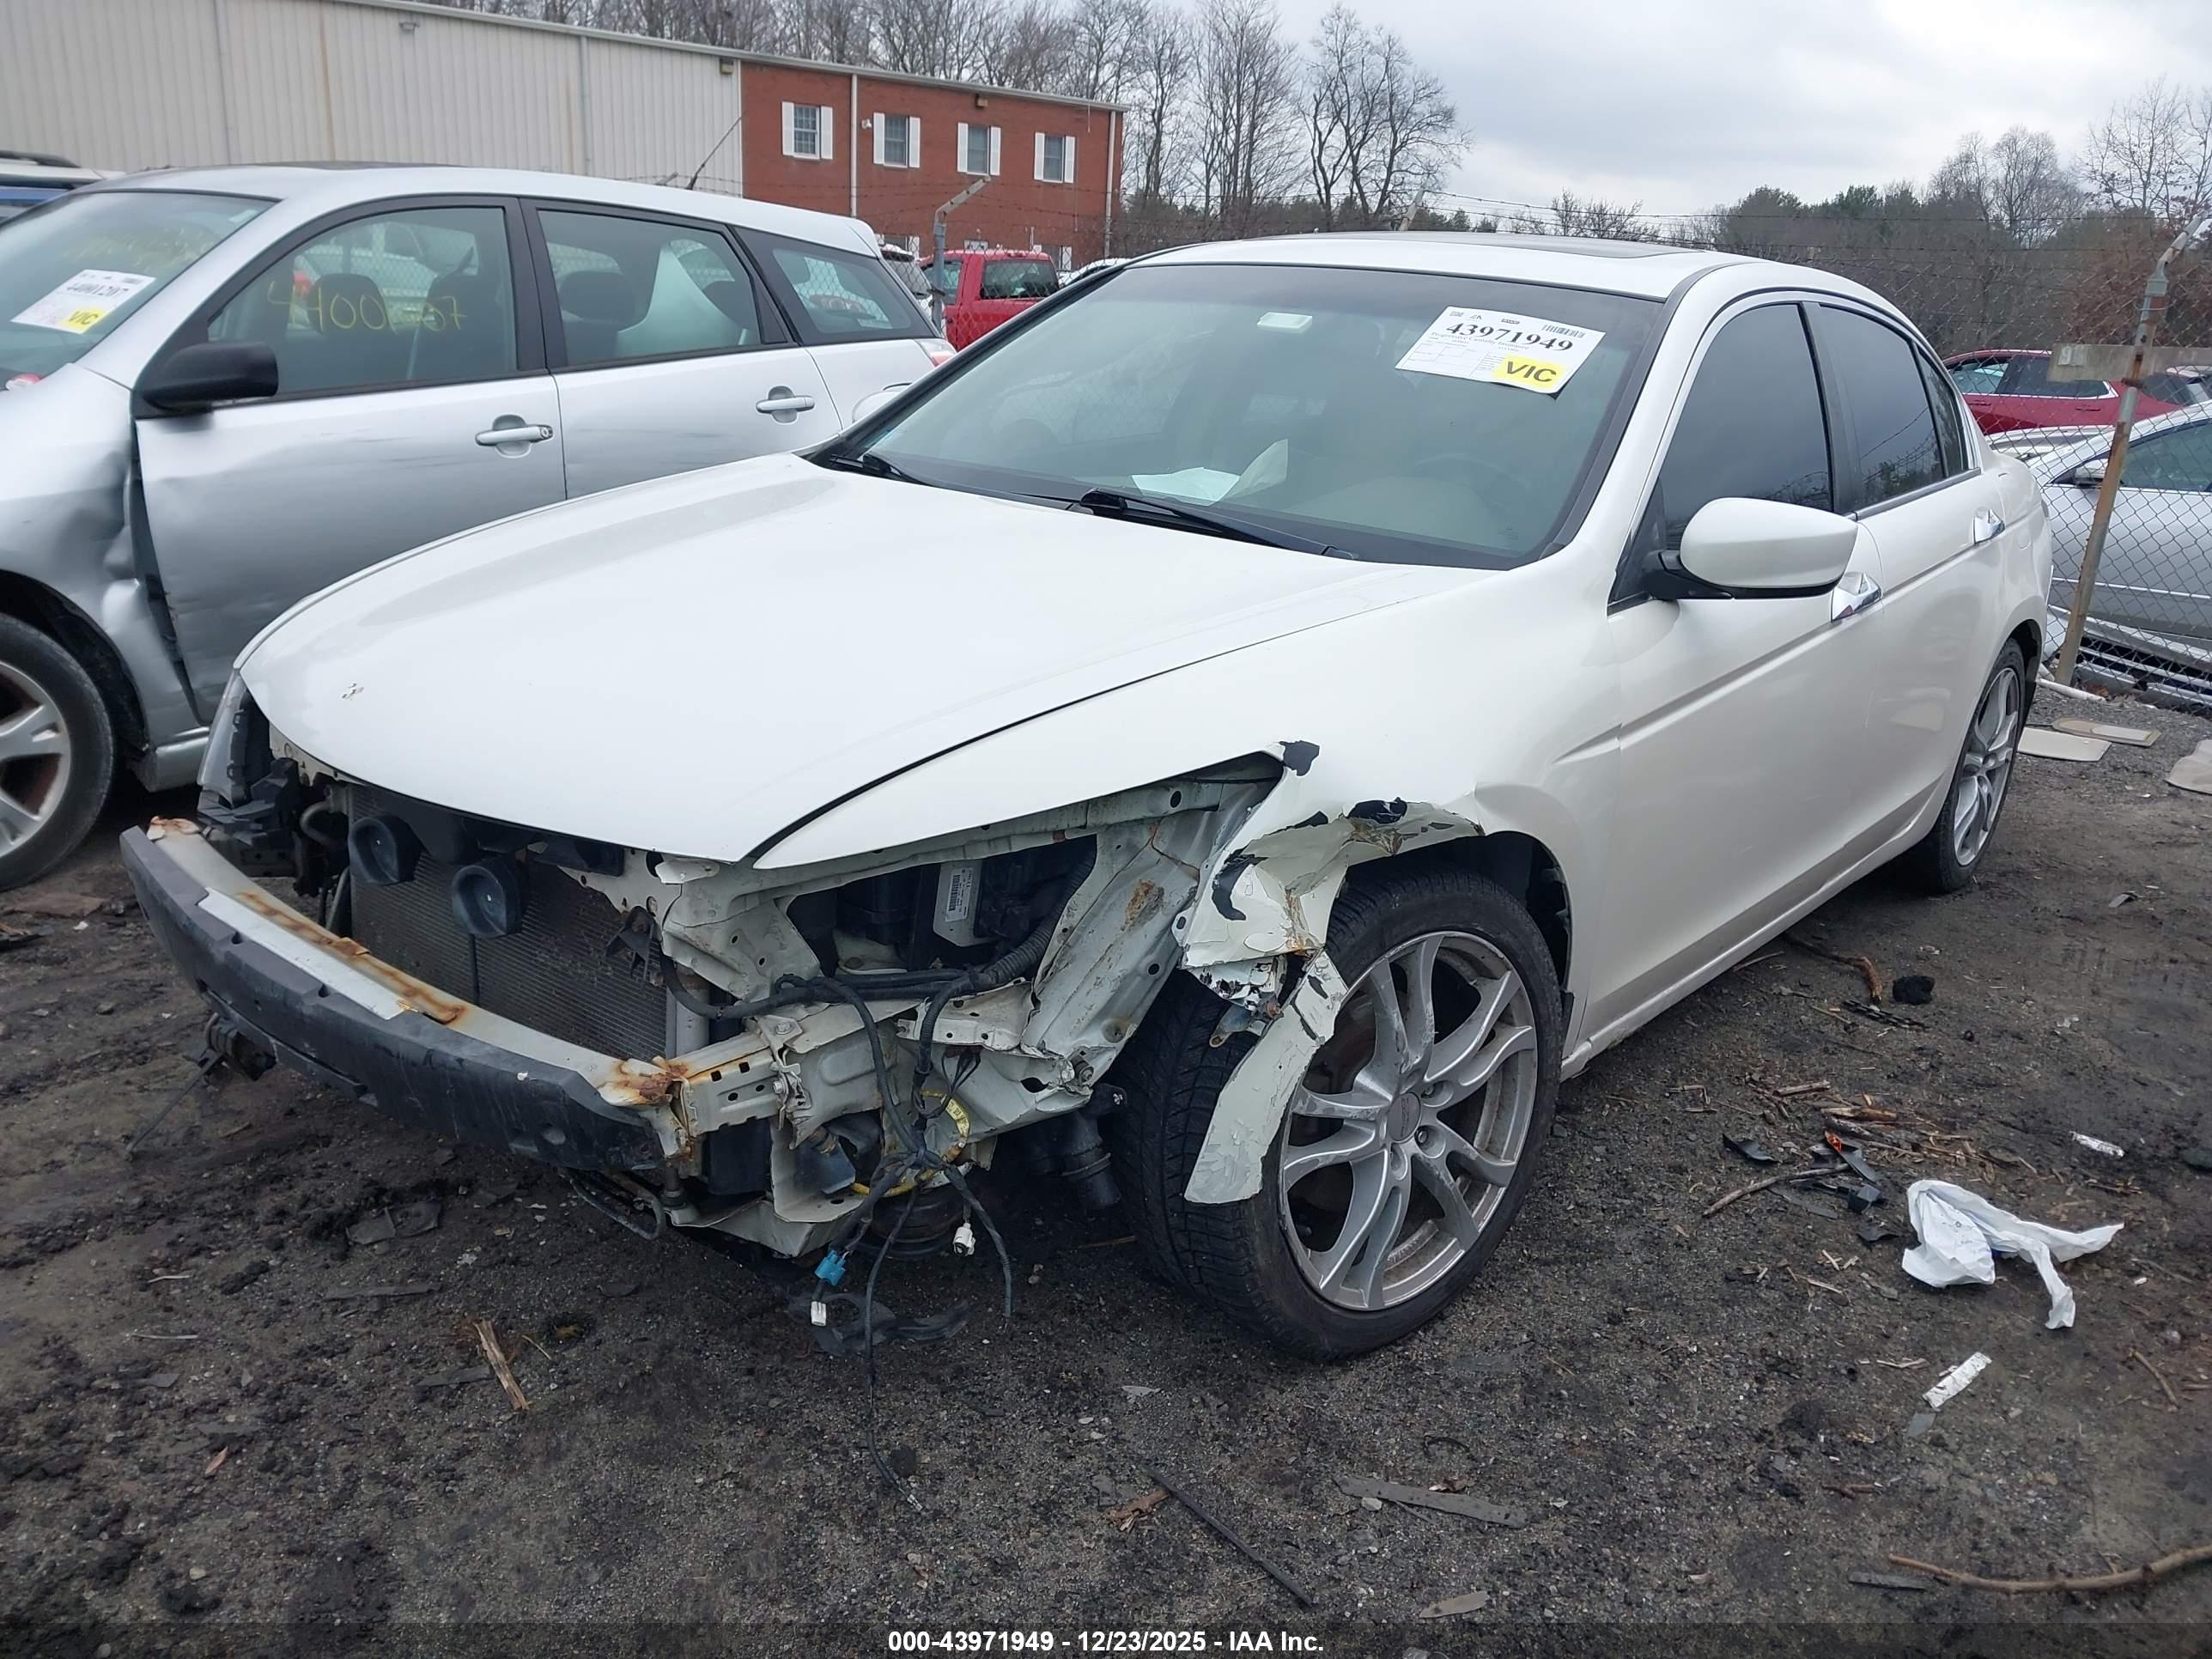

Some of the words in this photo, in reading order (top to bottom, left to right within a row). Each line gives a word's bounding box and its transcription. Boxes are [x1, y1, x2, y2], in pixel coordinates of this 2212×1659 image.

[68, 310, 99, 325] VIC
[1446, 322, 1574, 351] 43971949
[1506, 361, 1557, 382] VIC
